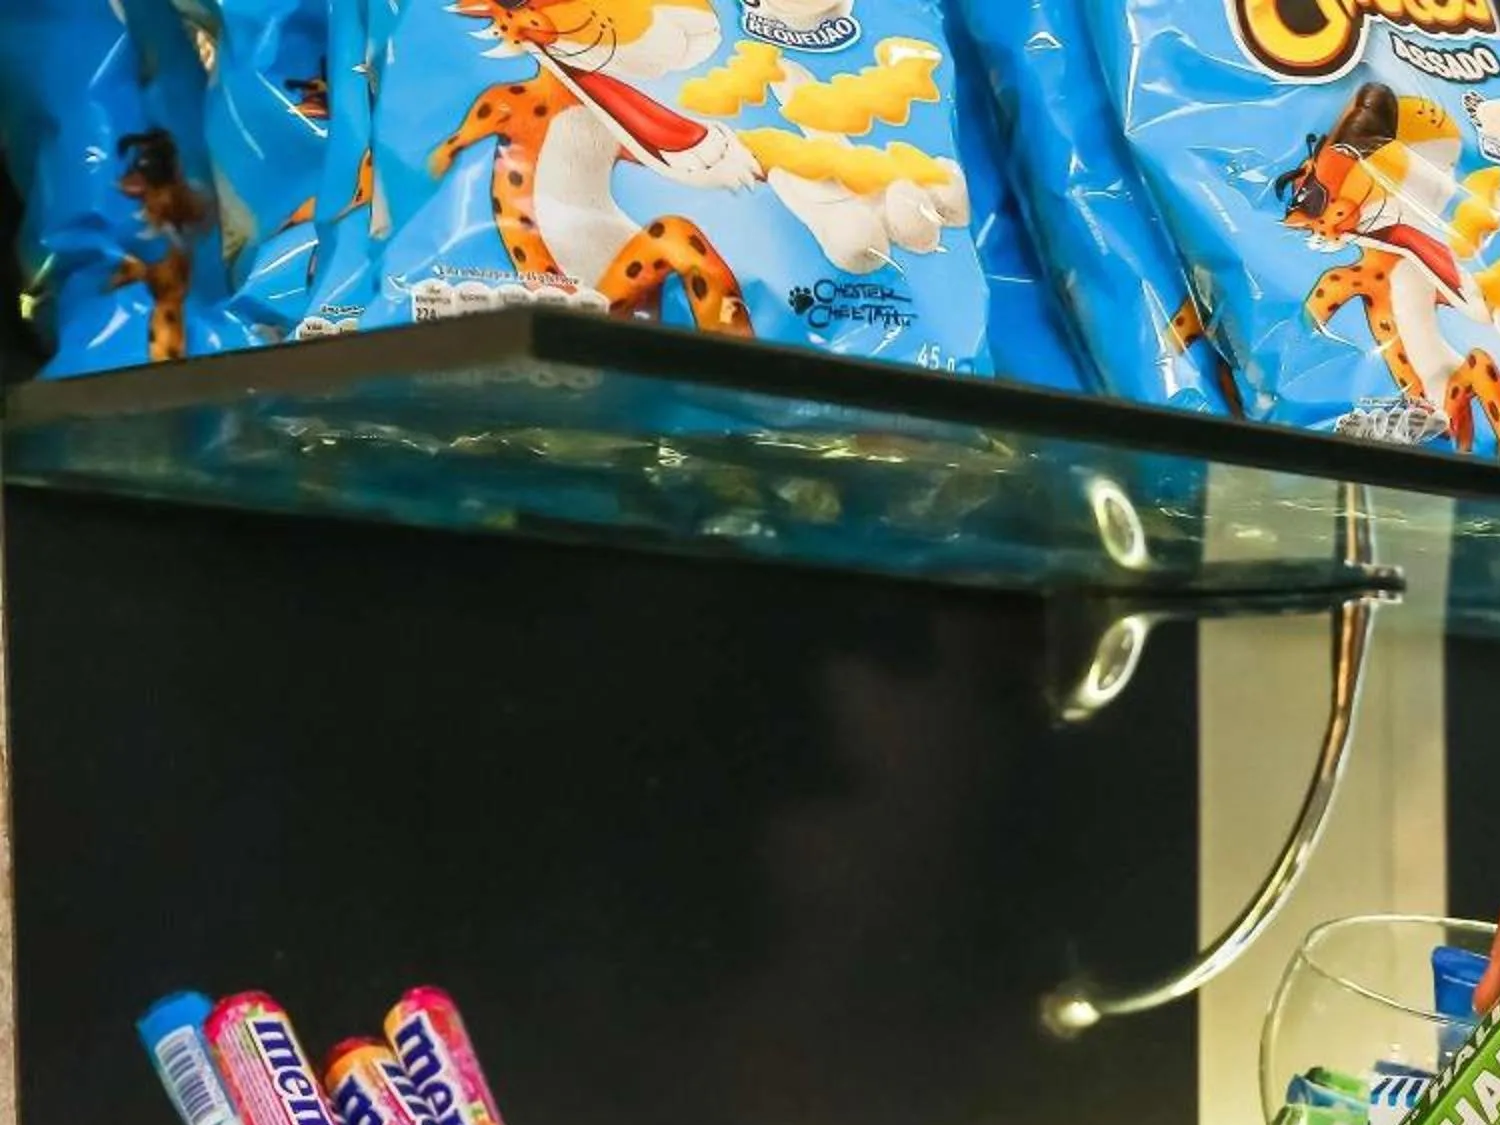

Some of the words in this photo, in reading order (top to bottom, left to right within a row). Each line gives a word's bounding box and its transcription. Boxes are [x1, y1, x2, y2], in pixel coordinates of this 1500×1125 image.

[749, 18, 852, 45] REQUEIJÃO
[1392, 35, 1500, 78] ASSADO
[917, 343, 942, 370] 45
